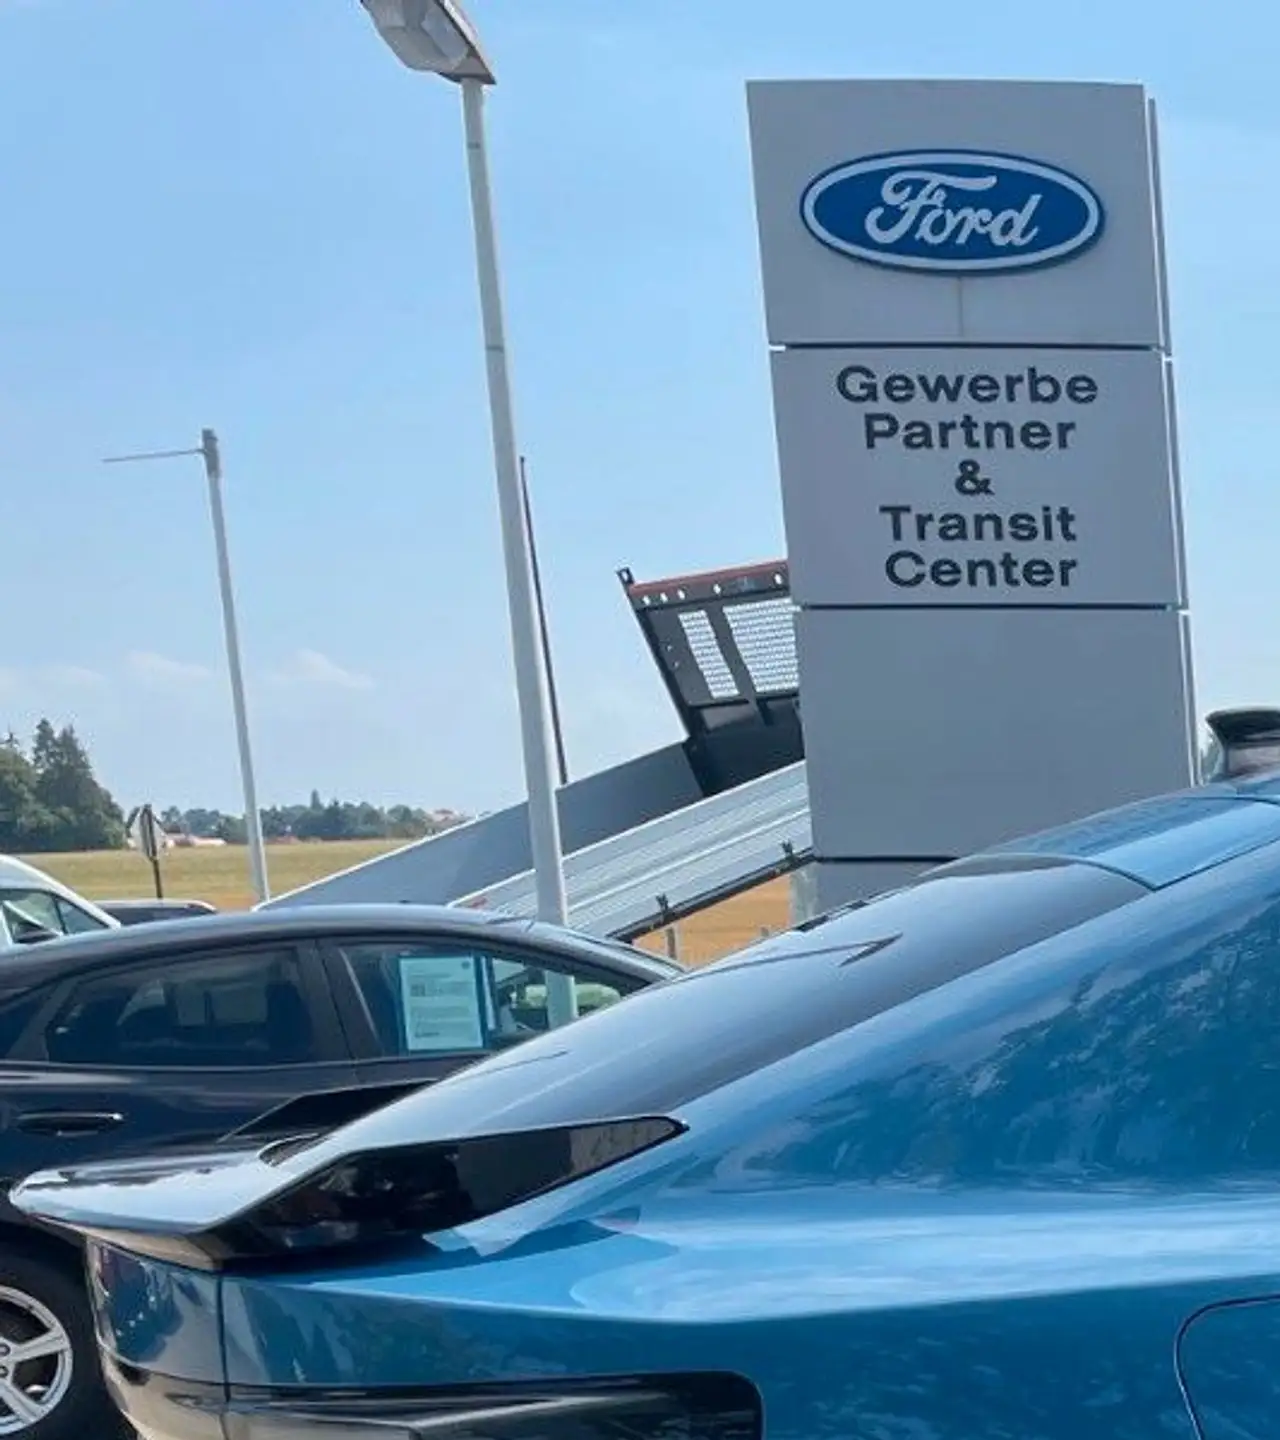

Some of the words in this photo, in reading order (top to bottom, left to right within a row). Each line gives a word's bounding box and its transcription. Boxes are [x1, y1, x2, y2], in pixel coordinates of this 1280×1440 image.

[865, 170, 1042, 246] Ford
[836, 364, 1099, 404] Gewerbe
[863, 412, 1077, 450] Partner
[954, 458, 996, 496] &
[878, 504, 1078, 542] Transit
[884, 549, 1079, 588] Center
